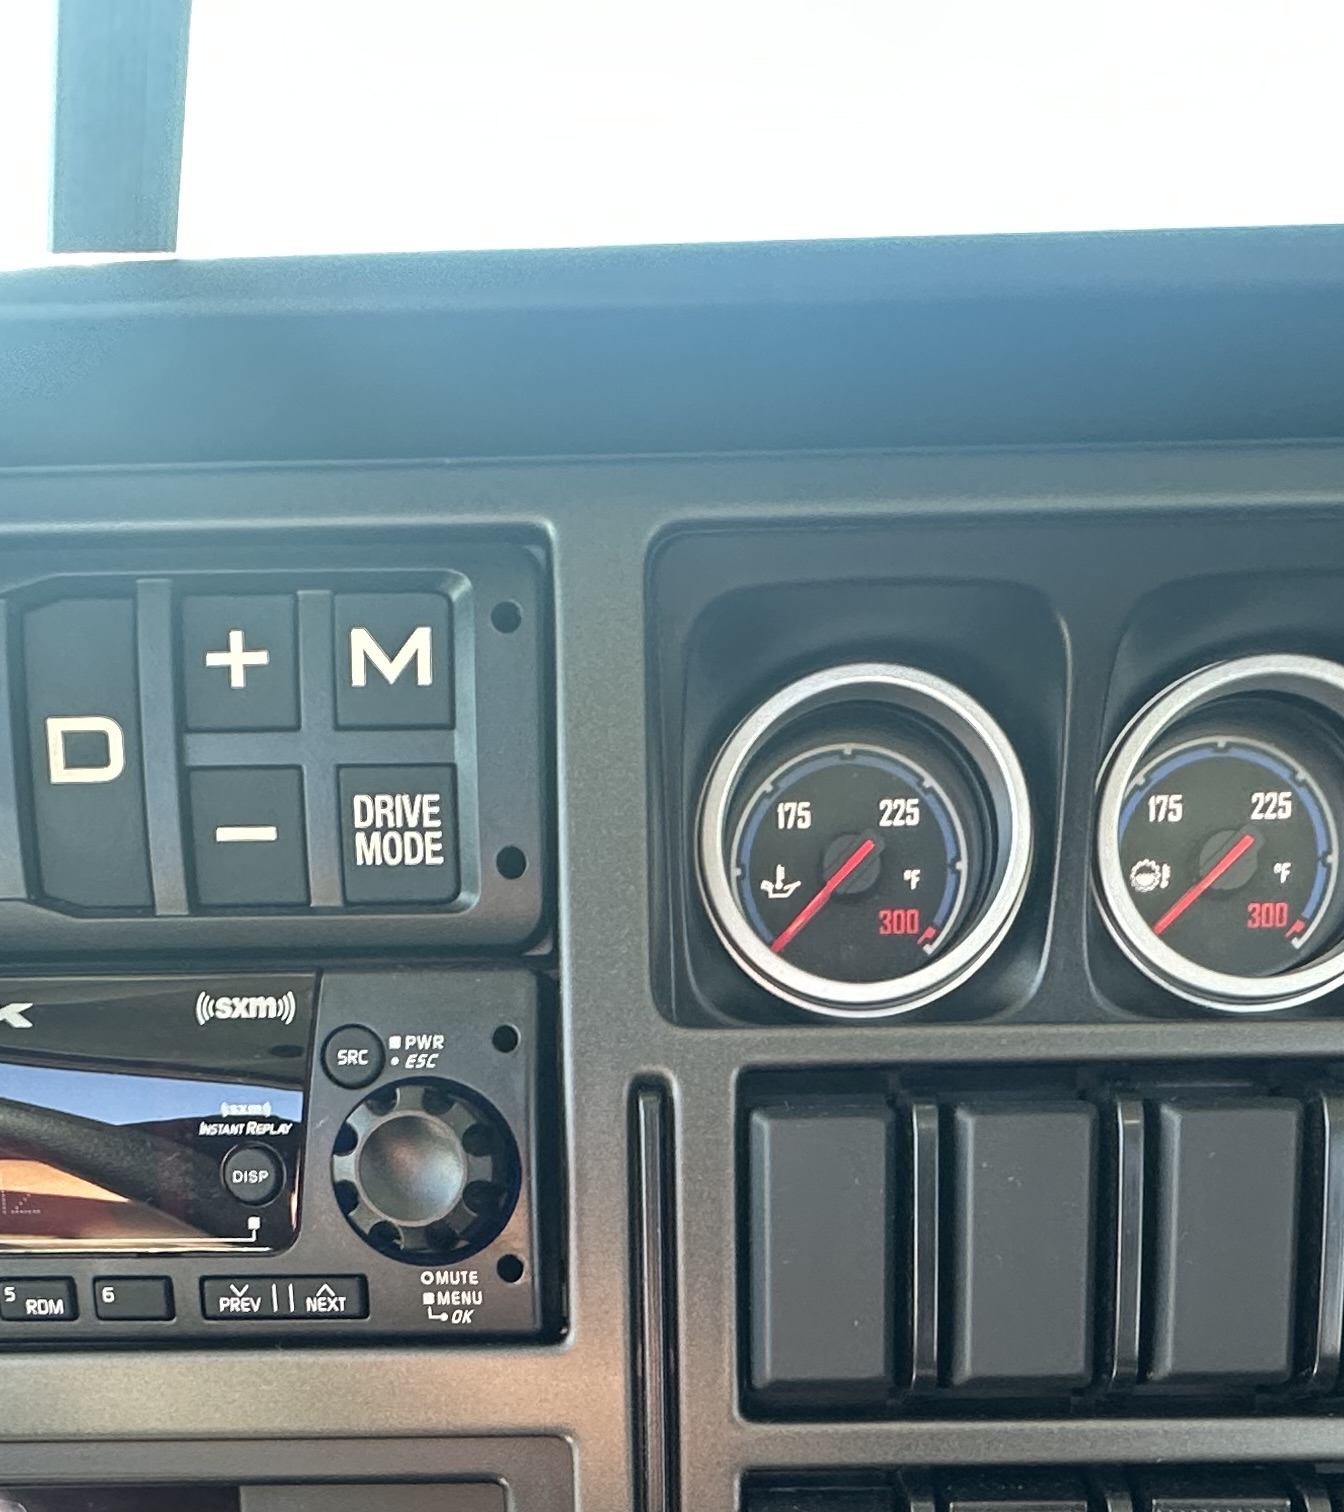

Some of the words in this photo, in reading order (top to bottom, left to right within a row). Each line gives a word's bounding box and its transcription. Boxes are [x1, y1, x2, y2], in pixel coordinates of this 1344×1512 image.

[350, 626, 433, 686] M
[45, 715, 125, 784] D
[353, 793, 441, 830] DRIVE
[879, 799, 920, 826] 225
[1147, 794, 1183, 822] 175
[1251, 792, 1293, 820] 225
[777, 802, 812, 829] 175
[355, 830, 444, 867] MODE
[878, 909, 919, 935] 300
[1247, 902, 1289, 929] 300
[404, 1035, 445, 1051] PWR
[336, 1050, 369, 1065] SRC
[404, 1053, 439, 1069] ESC
[232, 1170, 269, 1183] DISP
[435, 1271, 479, 1285] MUTE
[4, 1287, 16, 1302] 5
[102, 1286, 115, 1302] 6
[436, 1290, 483, 1305] MENU
[25, 1299, 64, 1316] RDM
[219, 1296, 262, 1312] PREV
[305, 1295, 346, 1312] NEXT
[451, 1309, 474, 1324] OK
